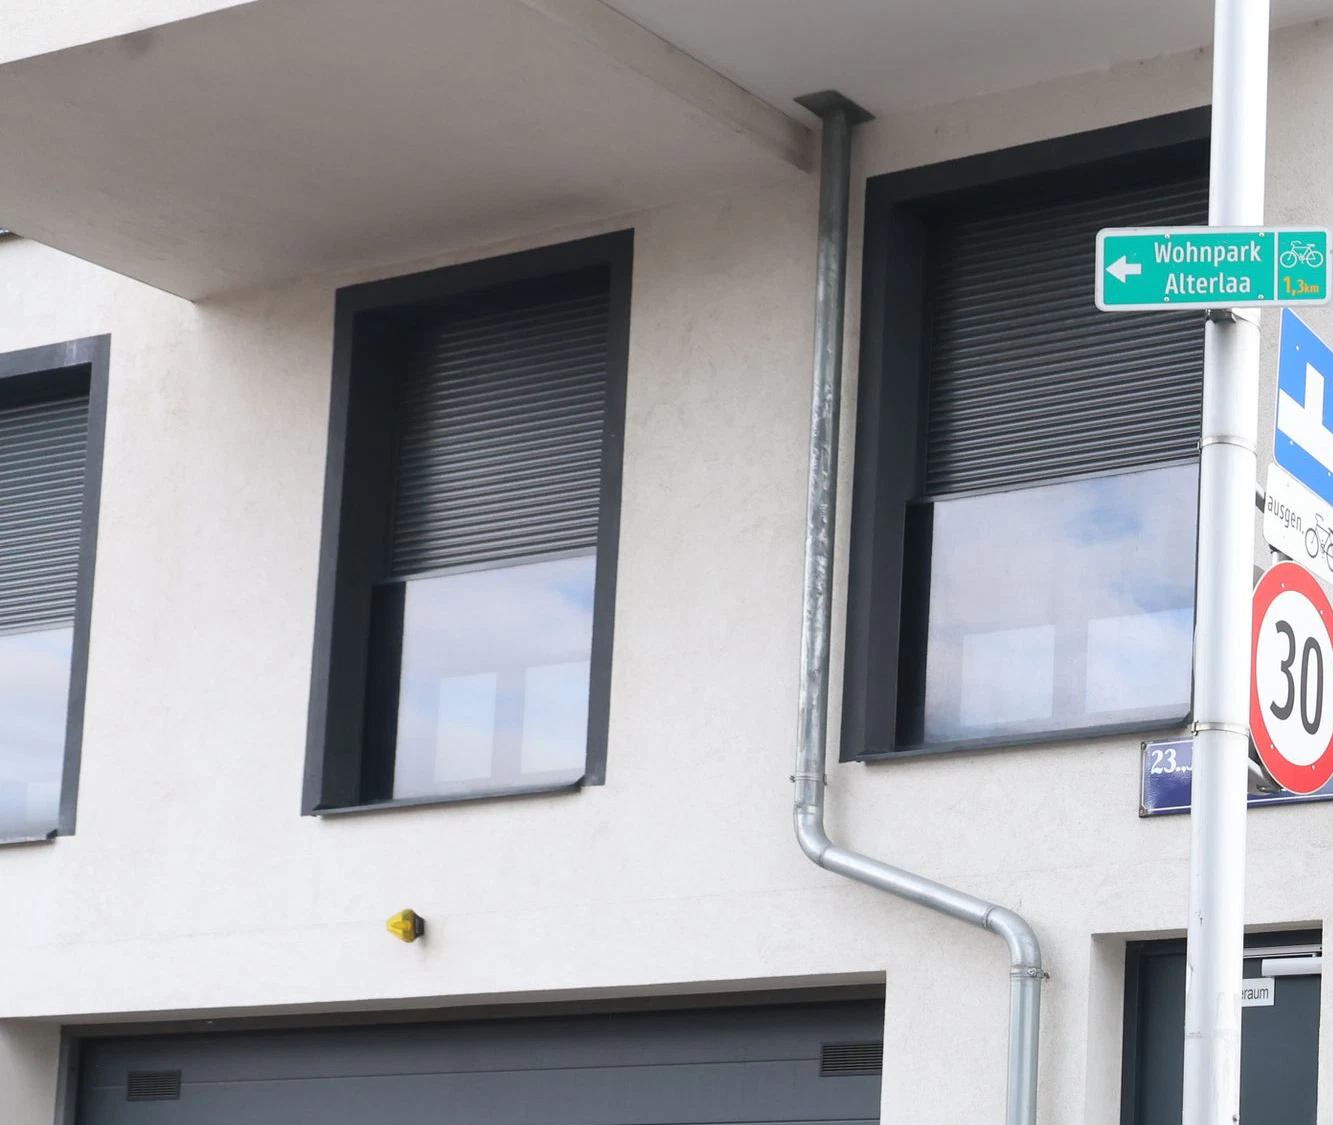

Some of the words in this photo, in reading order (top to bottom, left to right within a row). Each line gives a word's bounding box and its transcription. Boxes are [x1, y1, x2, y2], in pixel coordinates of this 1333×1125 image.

[1153, 240, 1262, 267] Wohnpark
[1164, 272, 1252, 295] Alterlaa
[1267, 495, 1305, 535] ausgen.
[1269, 619, 1325, 736] 30
